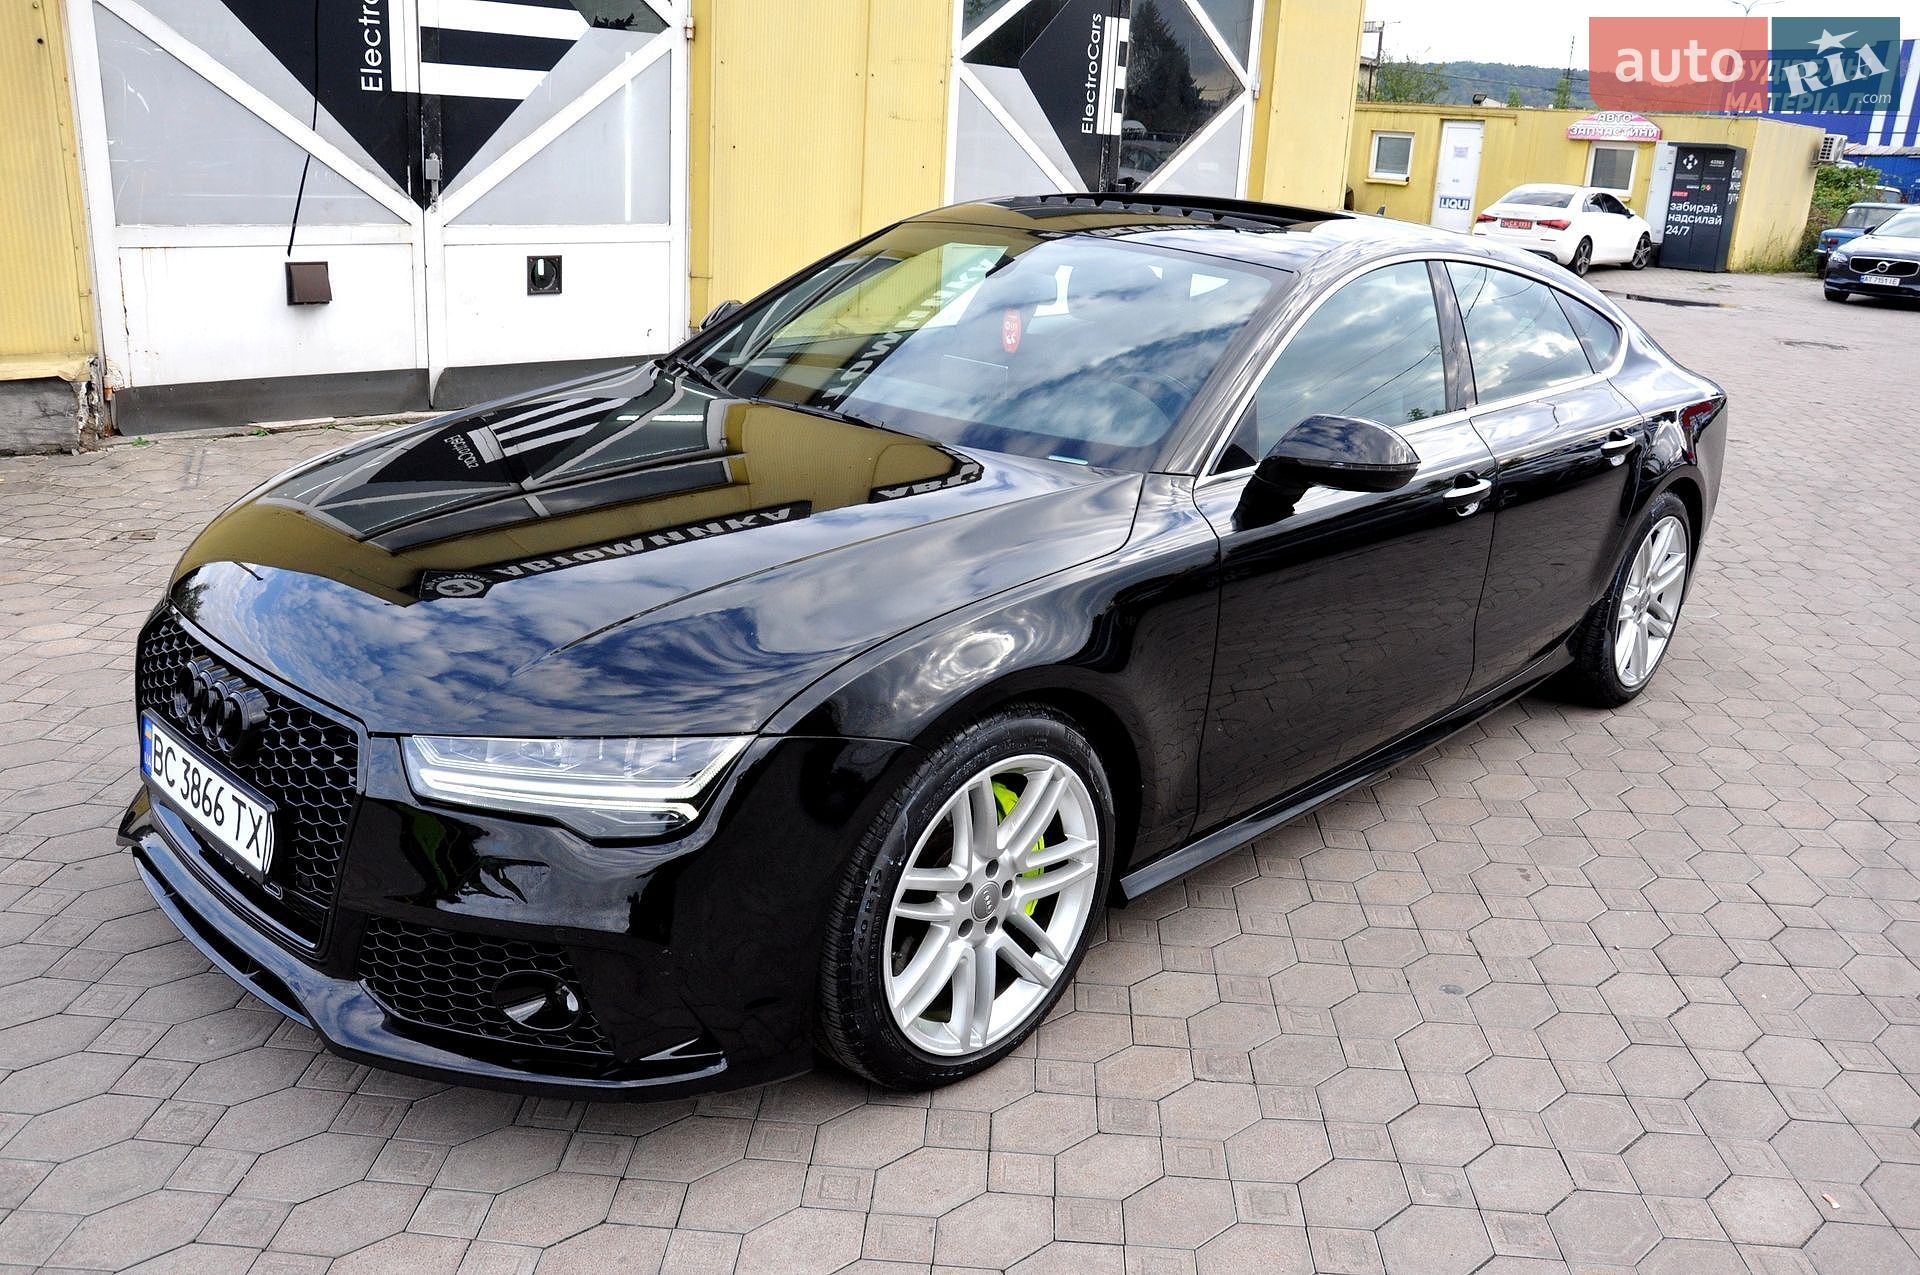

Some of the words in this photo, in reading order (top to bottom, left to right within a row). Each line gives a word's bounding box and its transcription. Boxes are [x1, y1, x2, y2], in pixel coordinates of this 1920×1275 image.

[358, 0, 383, 91] Electr
[1081, 13, 1102, 134] ElectroCars
[1597, 113, 1633, 122] АВТО
[1569, 126, 1658, 137] ЗАПЧАСТИНИ
[1441, 198, 1469, 210] LIQUI
[1670, 202, 1718, 214] забирай
[1668, 213, 1722, 225] надсилай
[1665, 225, 1690, 235] 24/7
[153, 733, 177, 787] BC
[180, 757, 225, 827] 3866
[231, 794, 263, 858] TX
